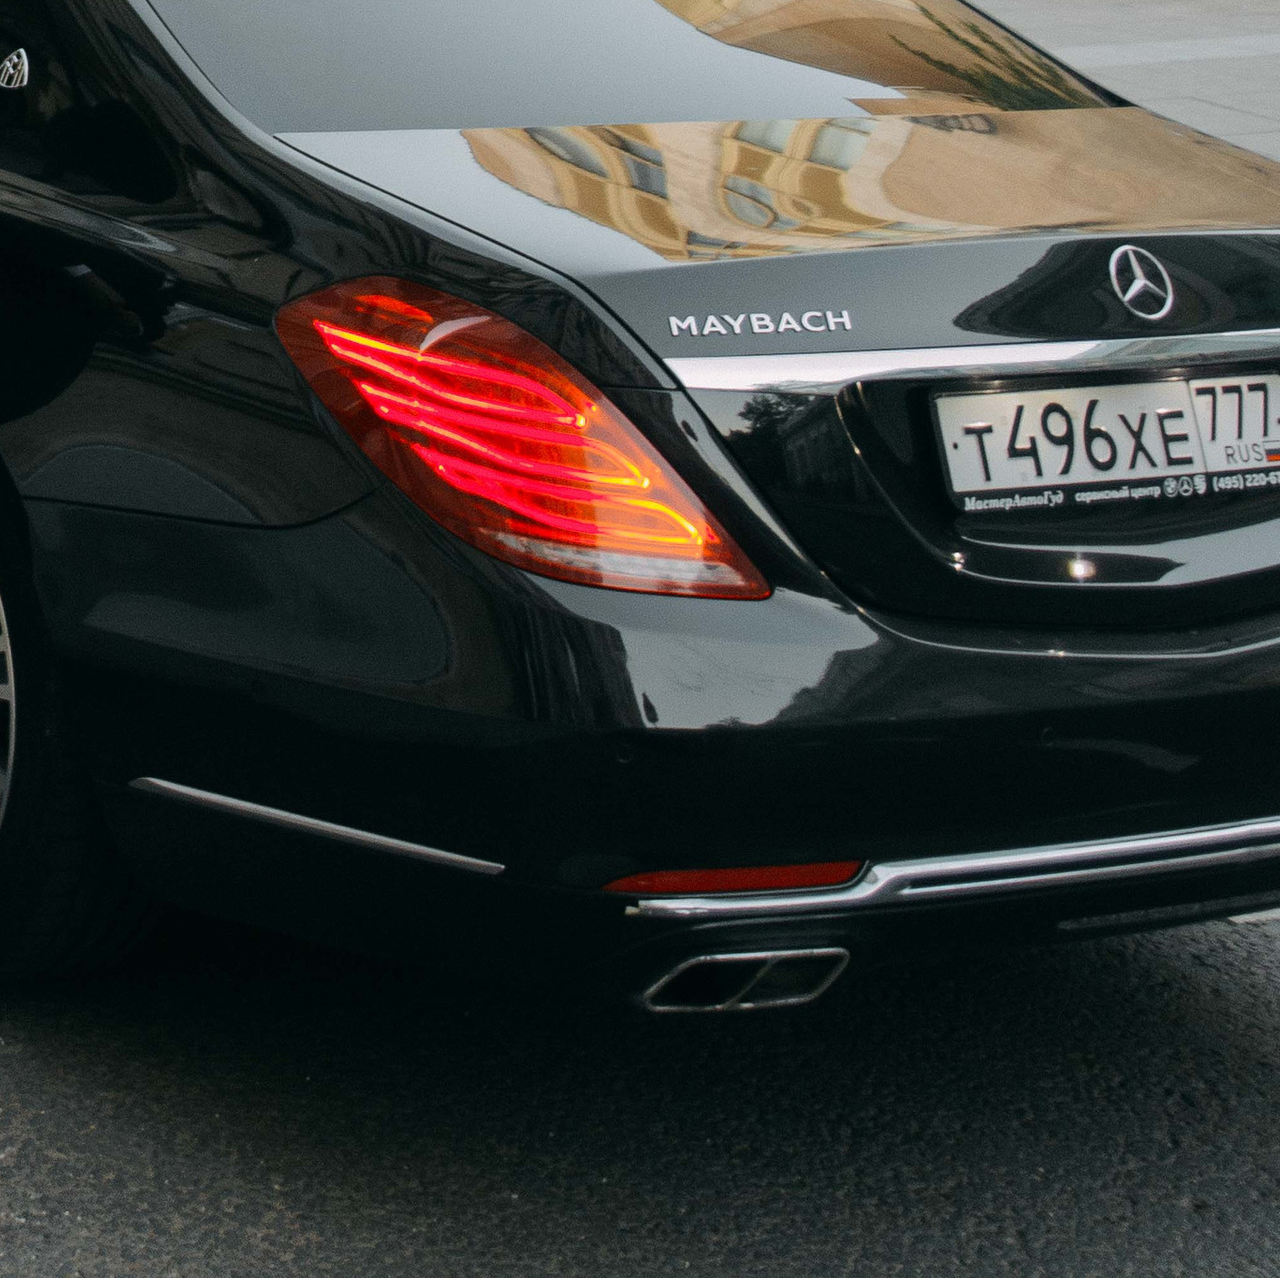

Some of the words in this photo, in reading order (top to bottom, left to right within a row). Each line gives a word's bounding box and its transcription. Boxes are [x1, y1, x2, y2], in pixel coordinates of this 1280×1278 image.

[669, 310, 852, 336] MAYBACH
[1195, 383, 1268, 442] 777
[1224, 443, 1264, 464] RUS
[1213, 474, 1244, 491] (495)
